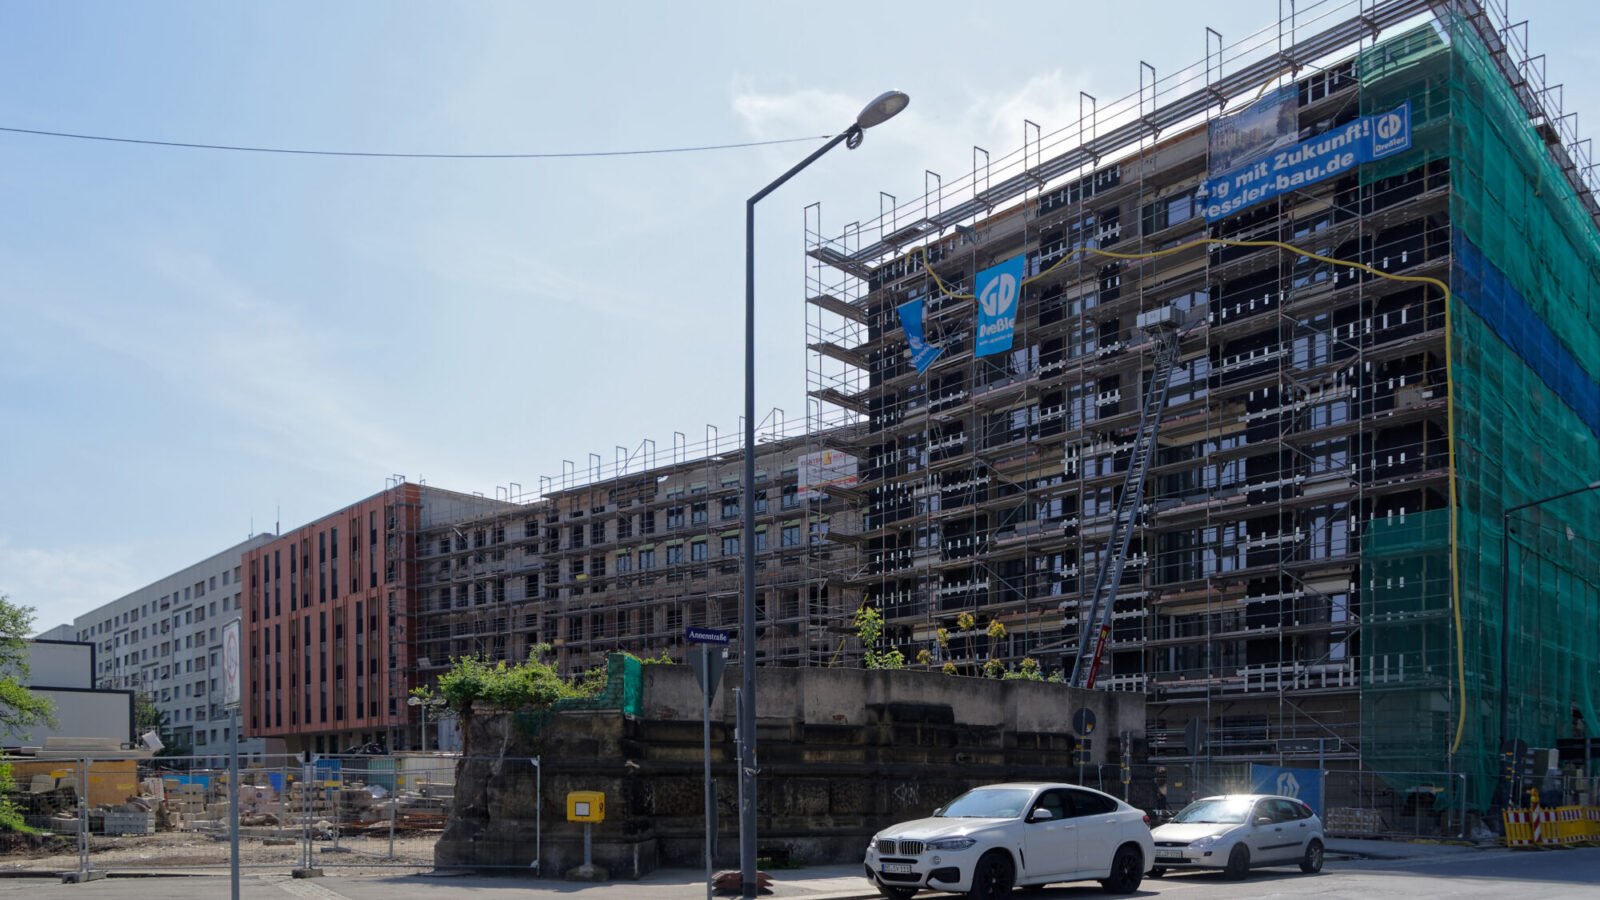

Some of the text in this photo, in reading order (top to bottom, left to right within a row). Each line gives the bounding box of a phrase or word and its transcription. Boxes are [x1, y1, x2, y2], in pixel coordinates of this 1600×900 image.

[1235, 161, 1268, 188] mit
[1273, 119, 1370, 171] Zukunft!
[688, 631, 727, 641] Annenstraße
